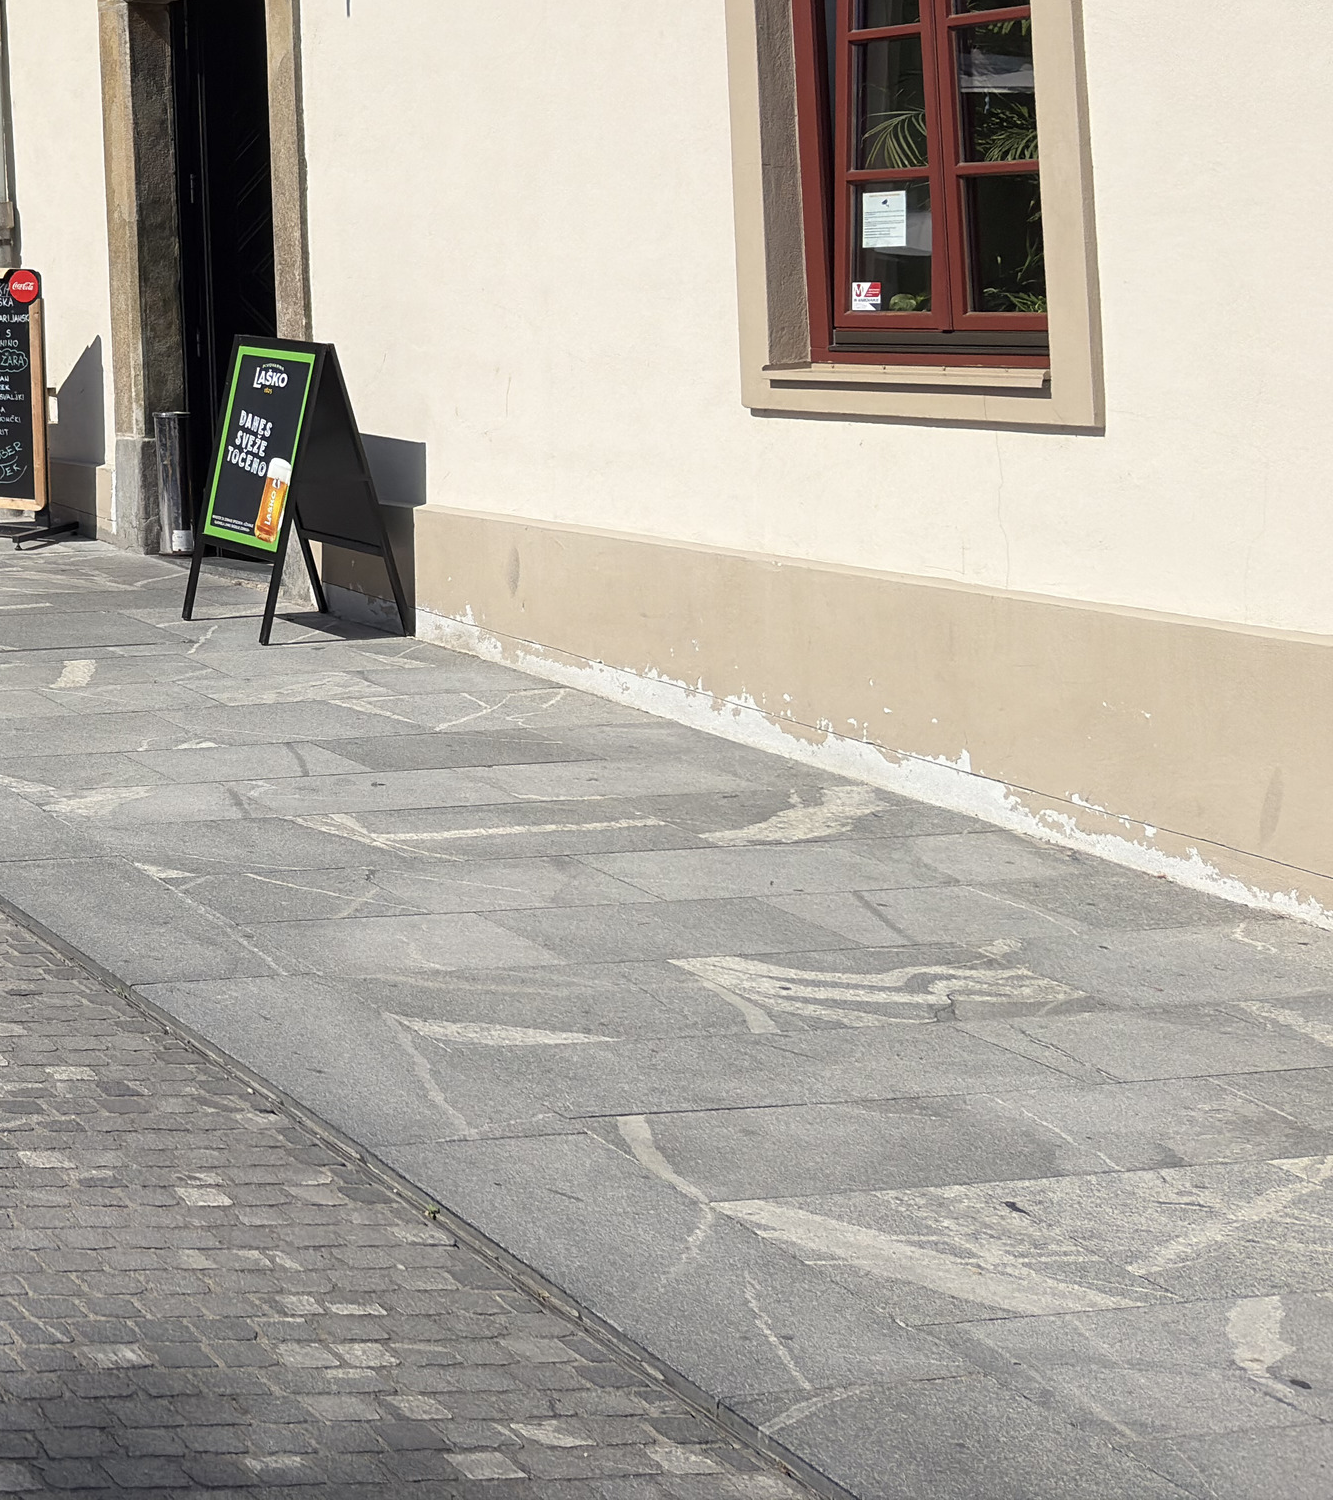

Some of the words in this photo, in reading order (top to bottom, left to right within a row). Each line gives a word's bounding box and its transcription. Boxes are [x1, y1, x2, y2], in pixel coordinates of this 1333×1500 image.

[253, 367, 288, 388] LAŠKO
[238, 409, 273, 438] DANES
[235, 430, 268, 457] SVEŽE
[226, 445, 267, 477] TOČENO
